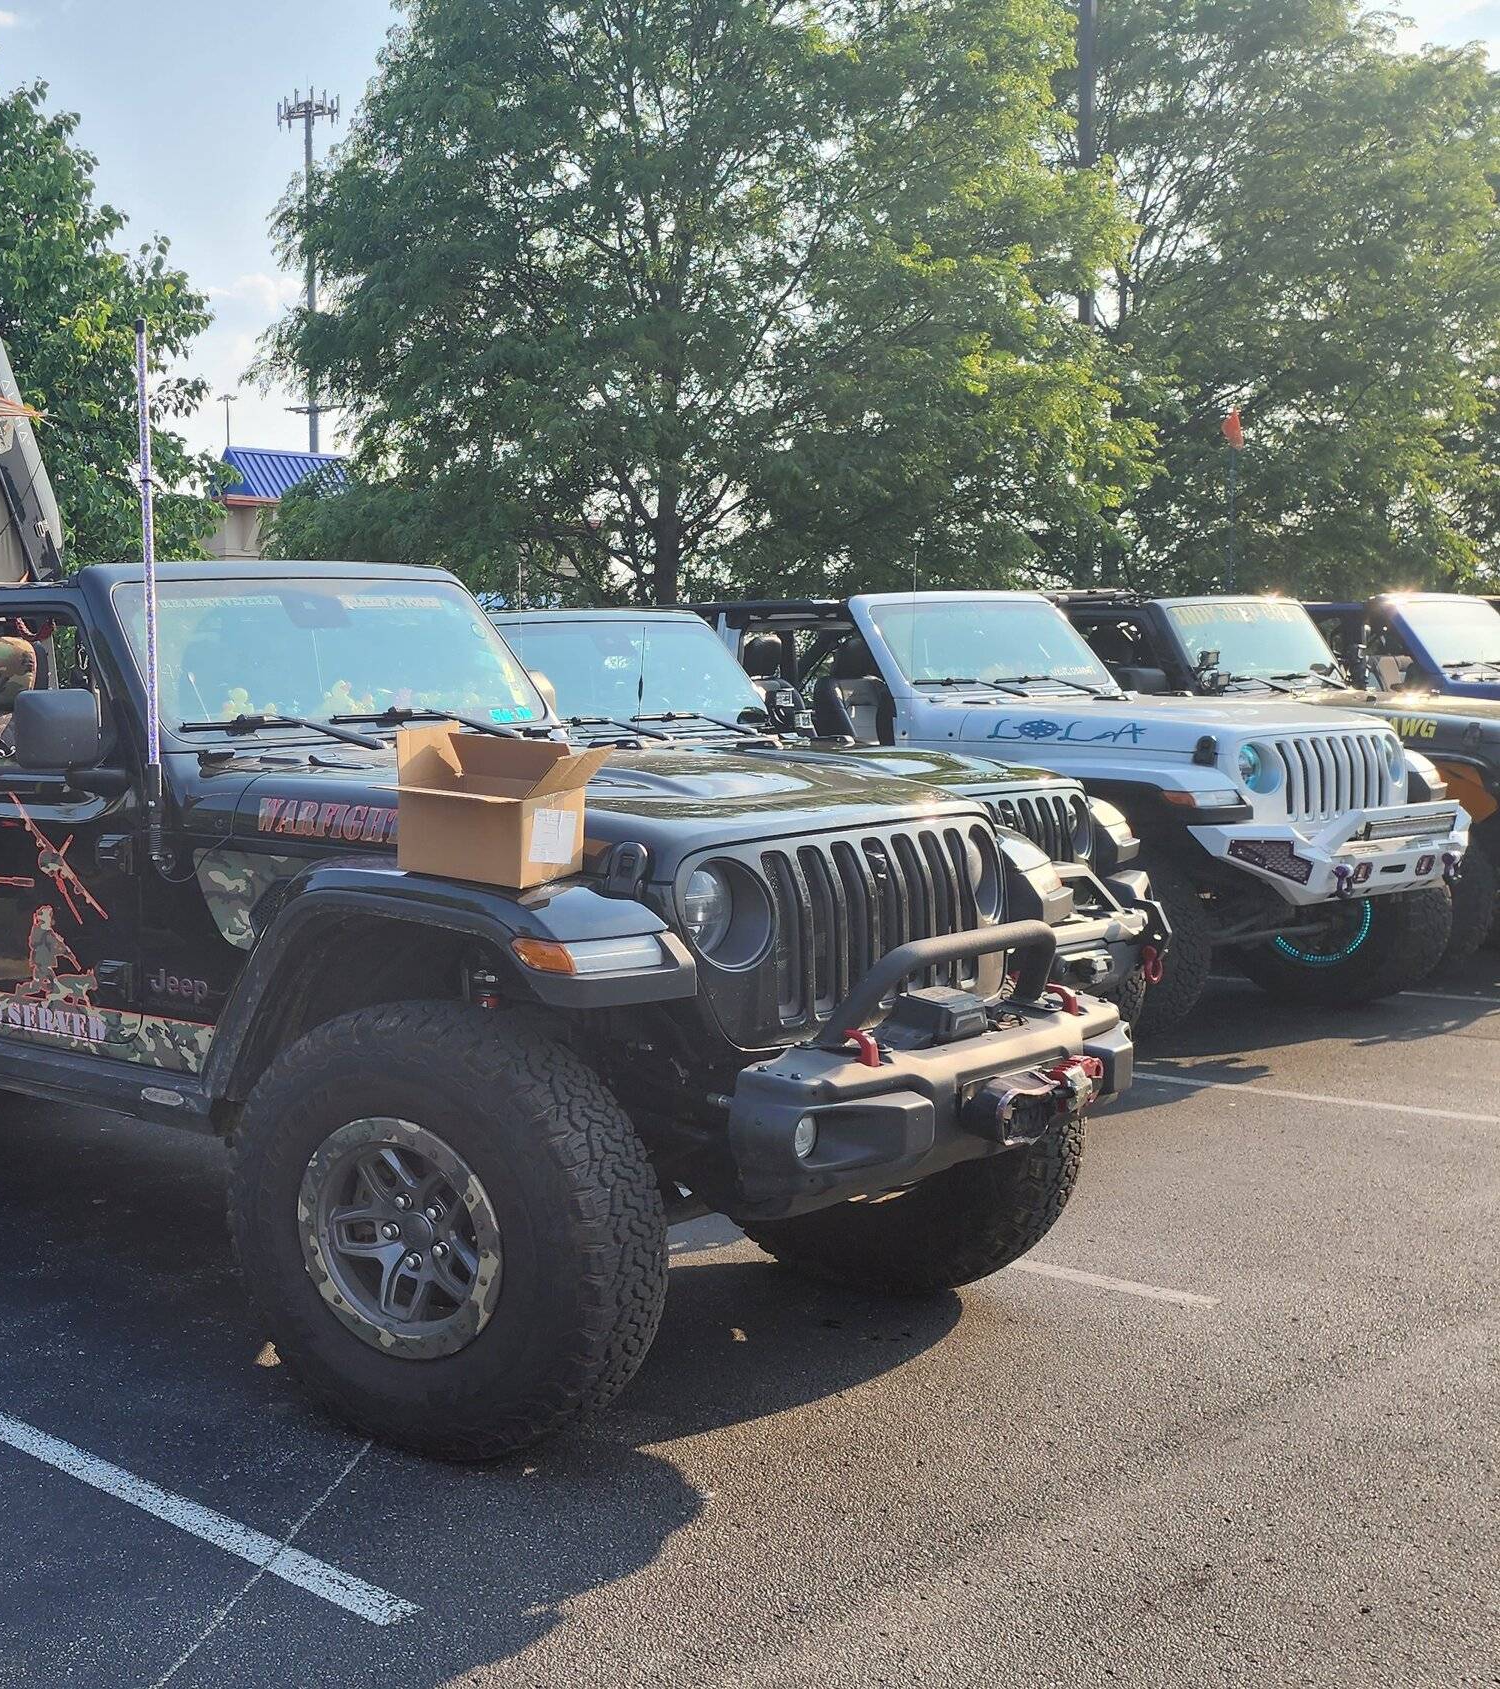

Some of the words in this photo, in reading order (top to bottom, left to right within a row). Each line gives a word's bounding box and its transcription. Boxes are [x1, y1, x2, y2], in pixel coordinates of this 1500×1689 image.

[1388, 717, 1437, 738] AWG
[150, 968, 208, 1004] Jeep
[7, 1002, 107, 1042] SERVED
